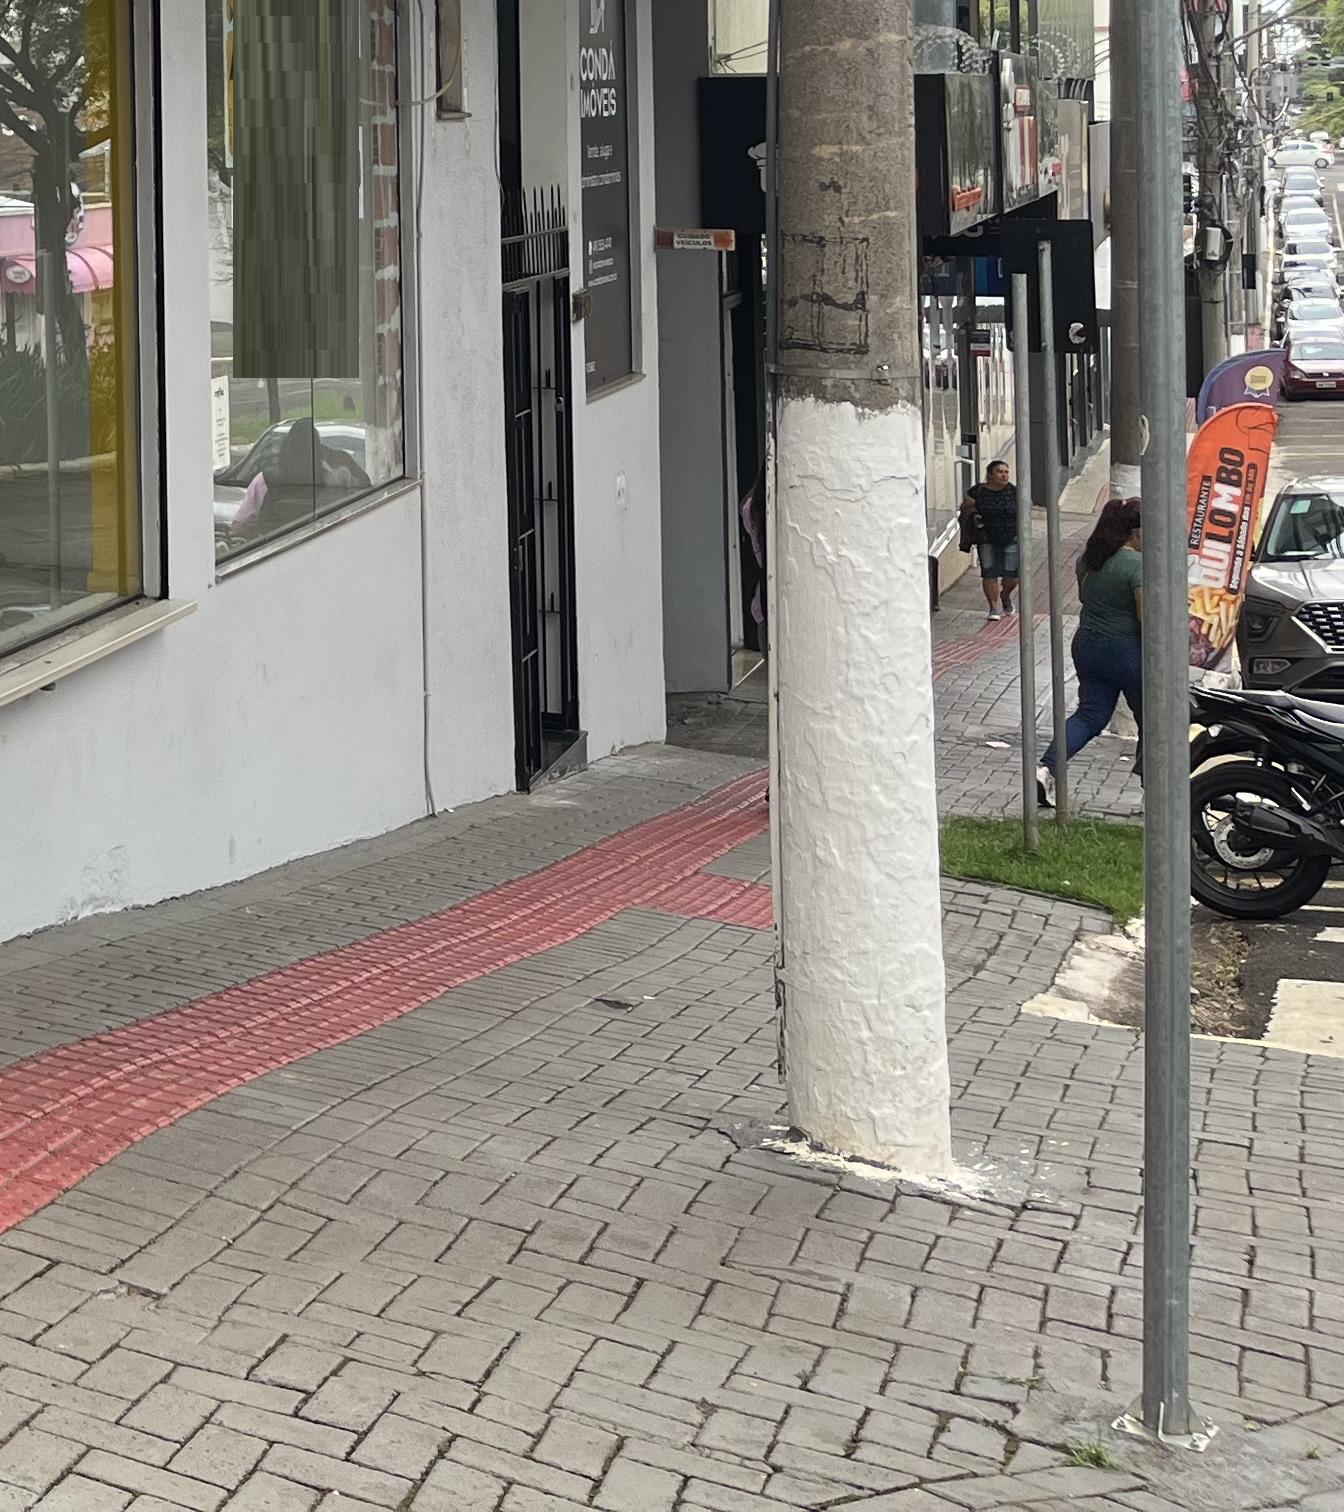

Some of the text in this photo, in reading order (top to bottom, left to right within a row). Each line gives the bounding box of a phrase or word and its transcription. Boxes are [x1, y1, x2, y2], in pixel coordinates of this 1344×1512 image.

[580, 40, 616, 81] CONDÁ
[580, 82, 617, 118] IMÓVEIS
[1189, 478, 1211, 546] RESTAURANTE
